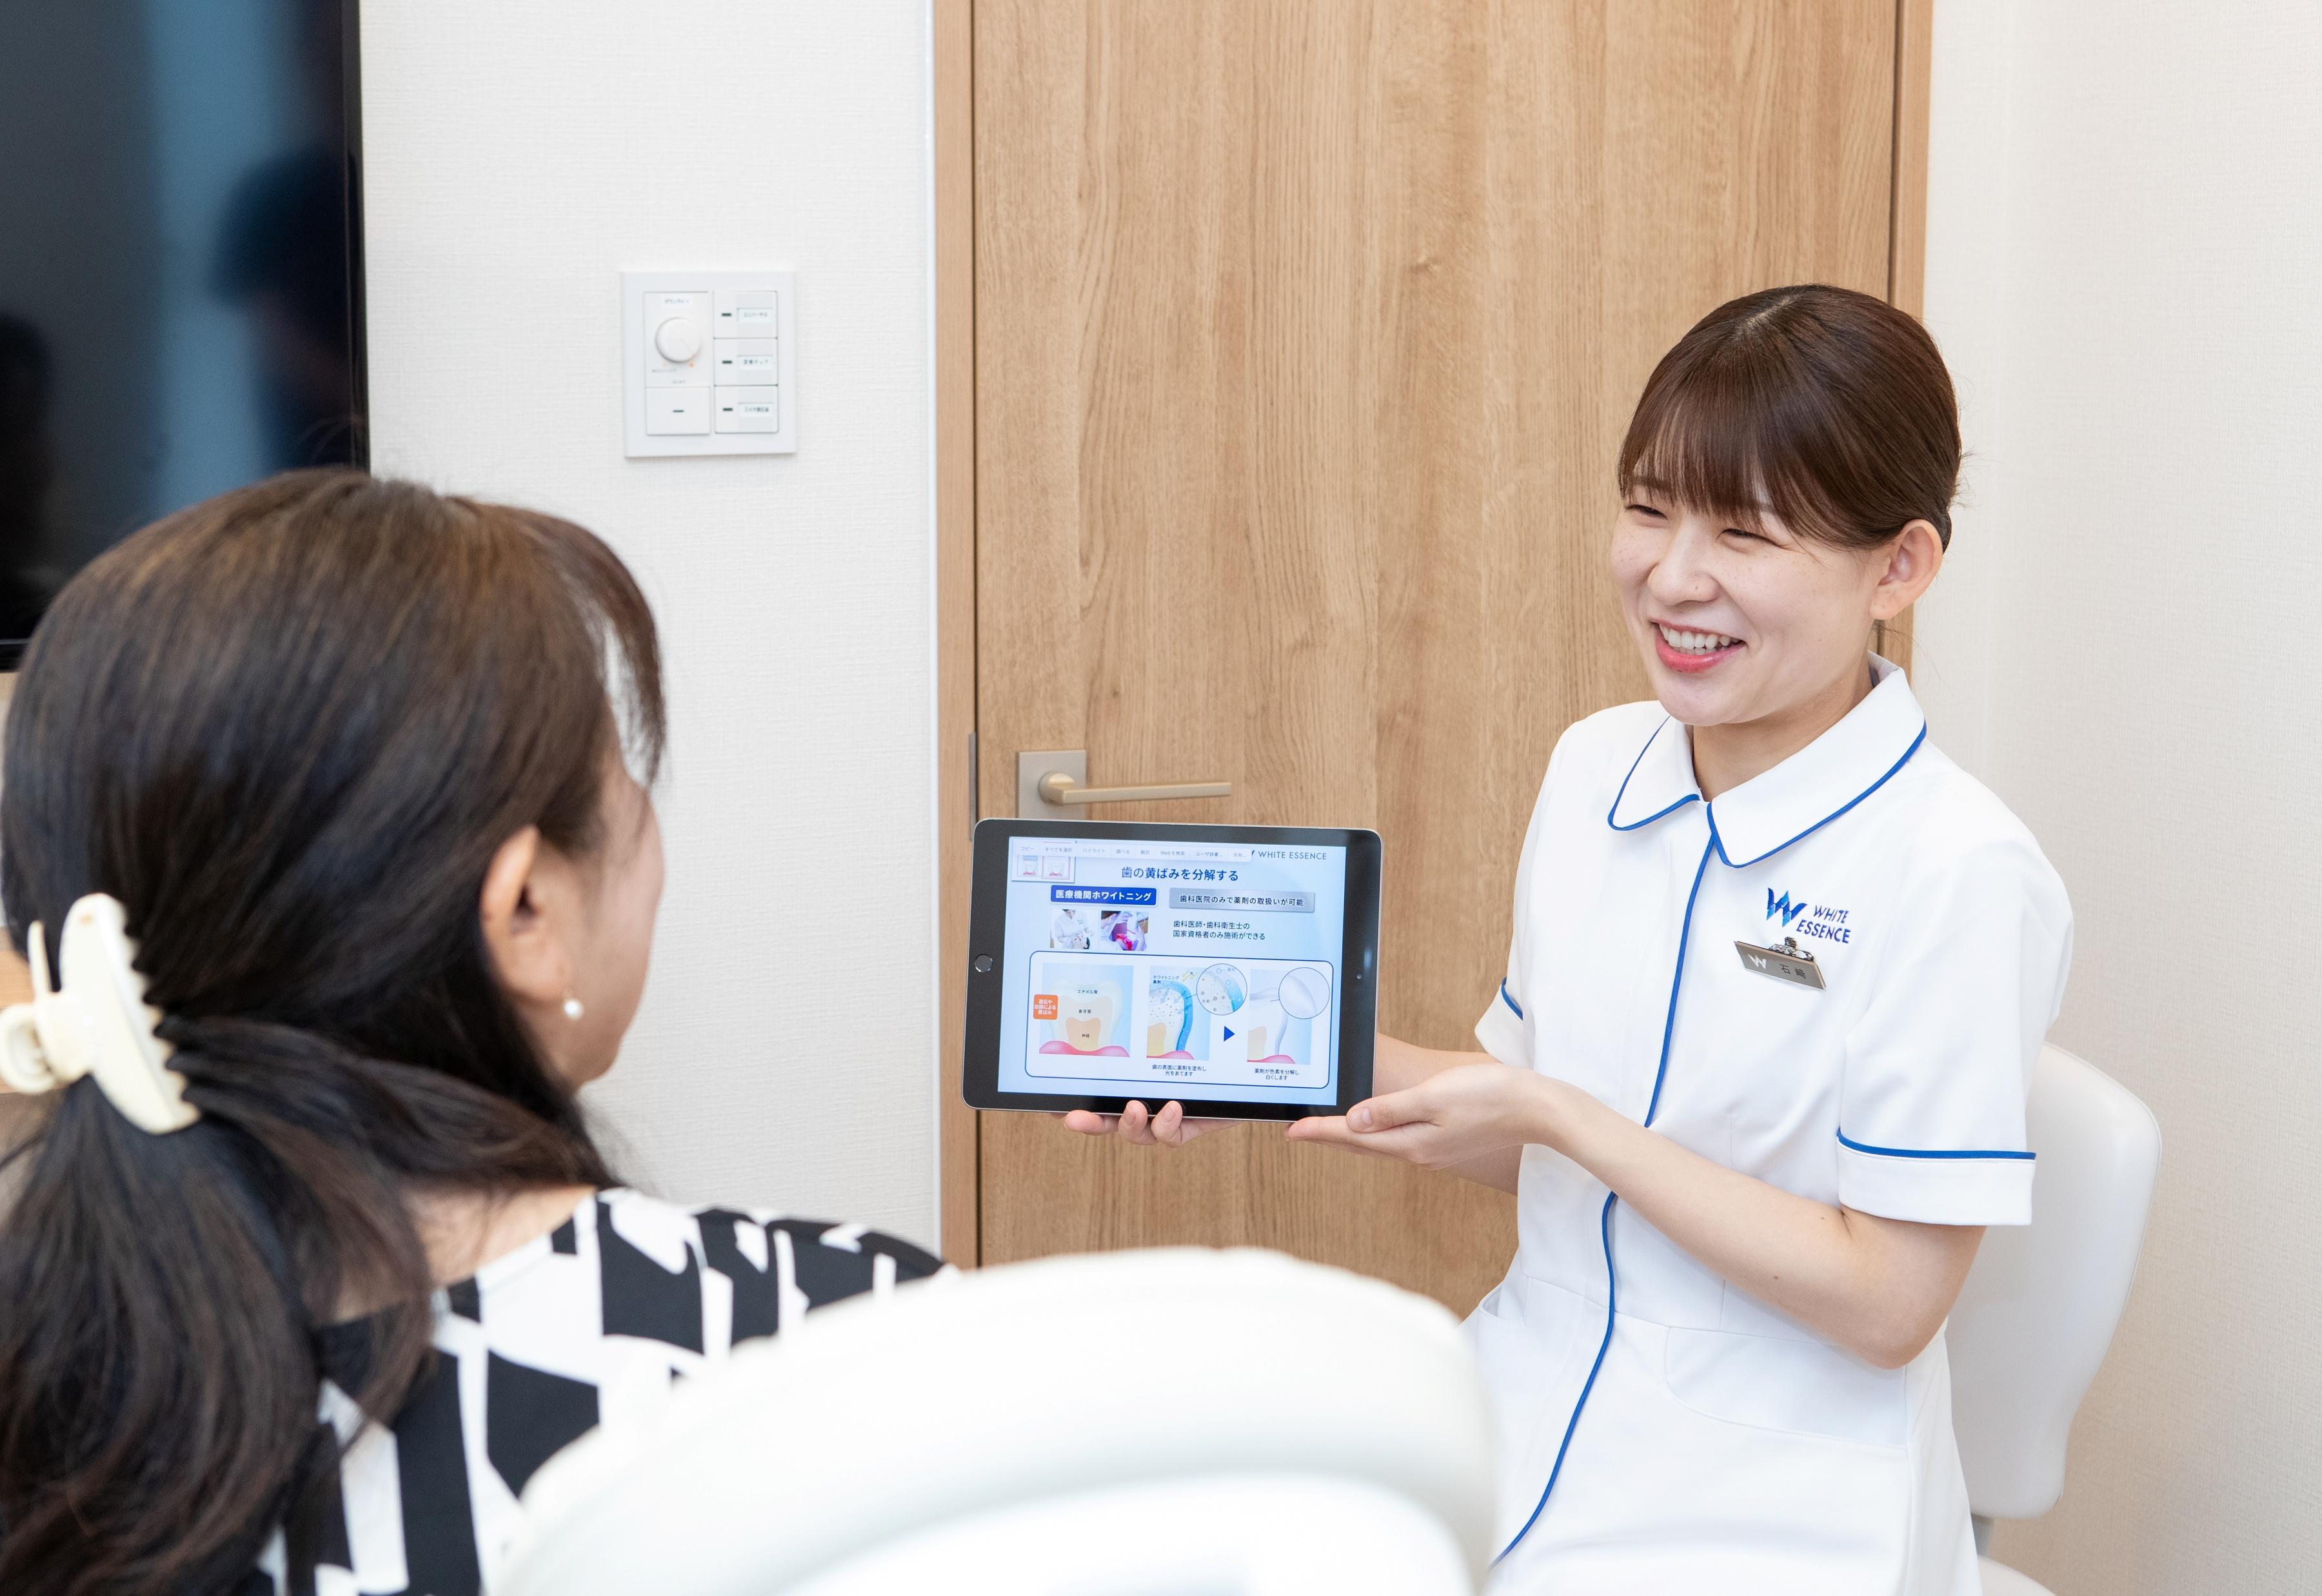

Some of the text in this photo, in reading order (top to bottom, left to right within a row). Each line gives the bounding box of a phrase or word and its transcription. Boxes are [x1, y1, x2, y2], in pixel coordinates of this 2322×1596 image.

[1258, 851, 1327, 860] WHITE ESSENCE
[1121, 866, 1238, 882] 歯の黄ばみを分解する
[1055, 889, 1152, 901] 医療機関ホワイトニング
[1180, 895, 1304, 907] 歯科医院のみで薬剤の取扱いが可能
[1813, 905, 1849, 924] WHITE
[1173, 920, 1250, 930] 歯科医師・歯科衛生士の
[1173, 930, 1265, 940] 国家資格者のみ施術ができる
[1796, 919, 1851, 944] ESSENCE
